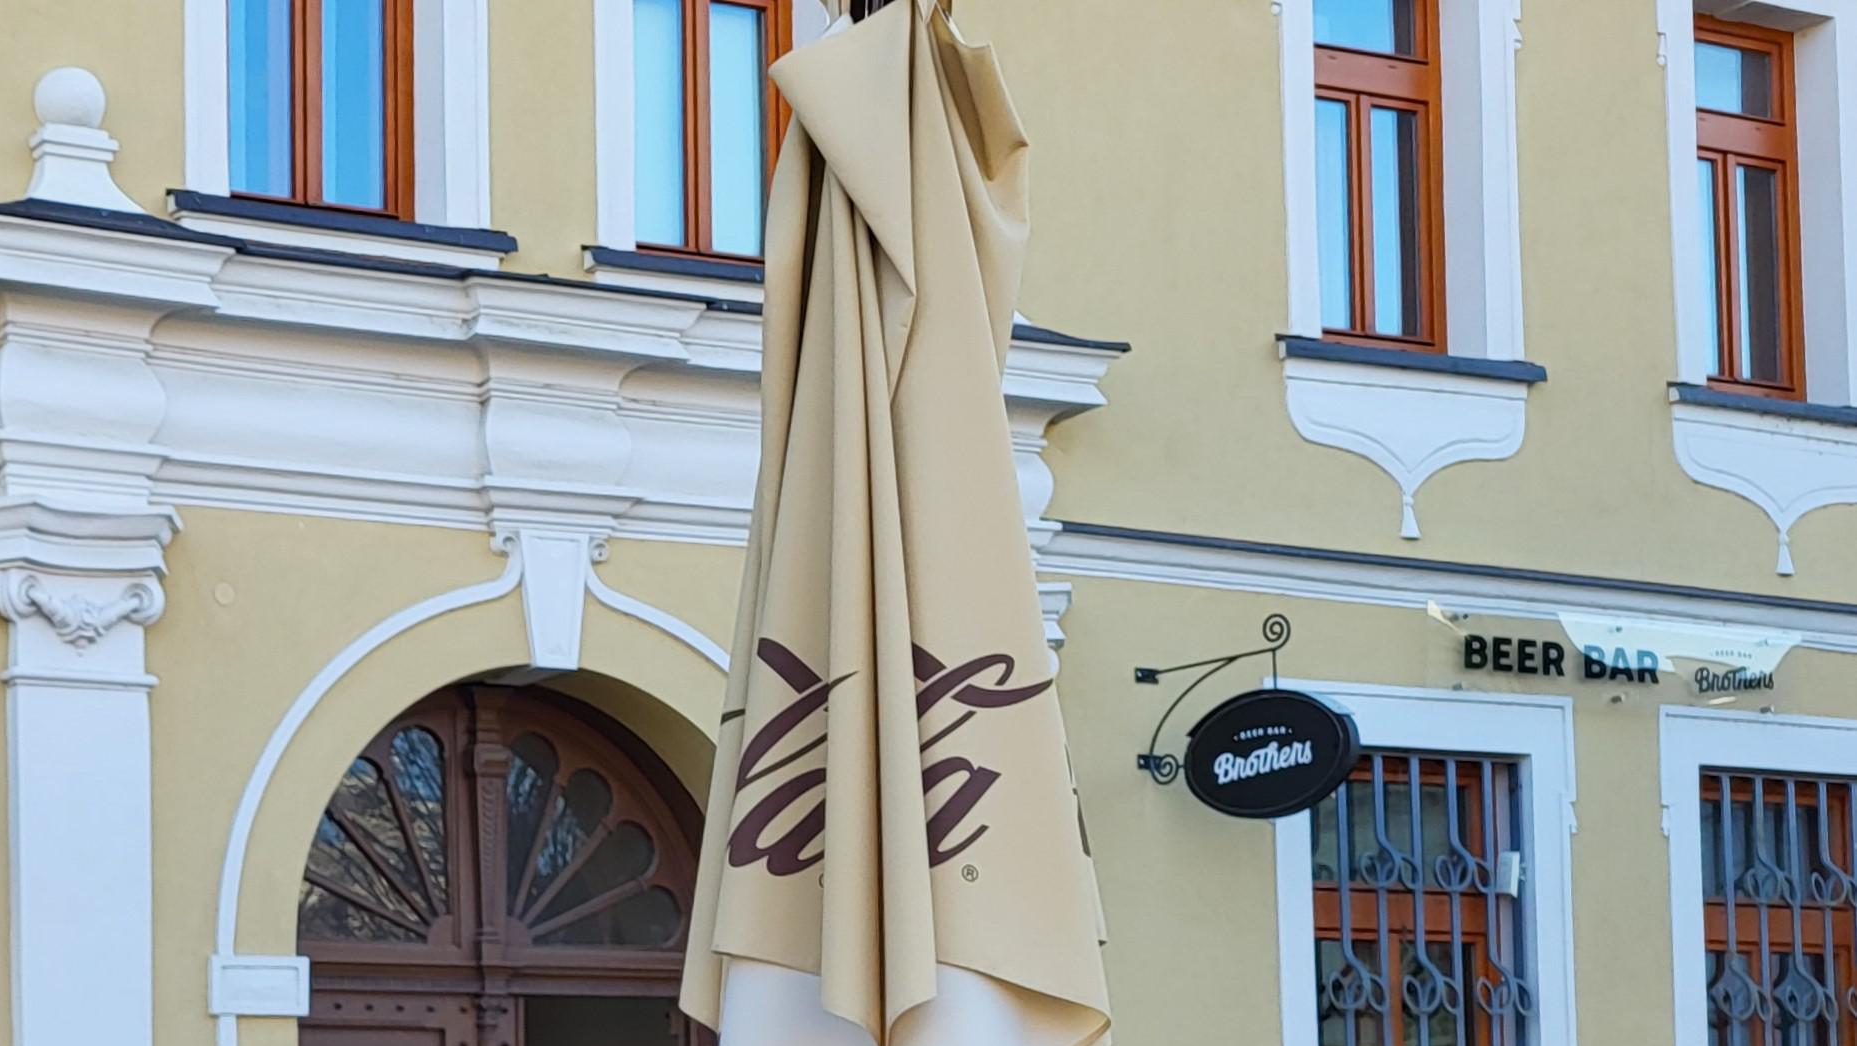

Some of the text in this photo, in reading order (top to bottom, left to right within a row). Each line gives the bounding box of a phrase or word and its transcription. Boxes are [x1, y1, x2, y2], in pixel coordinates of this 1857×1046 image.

[1463, 633, 1660, 685] BEER BAR
[1694, 665, 1775, 694] Brothers
[1213, 740, 1314, 785] Brothers
